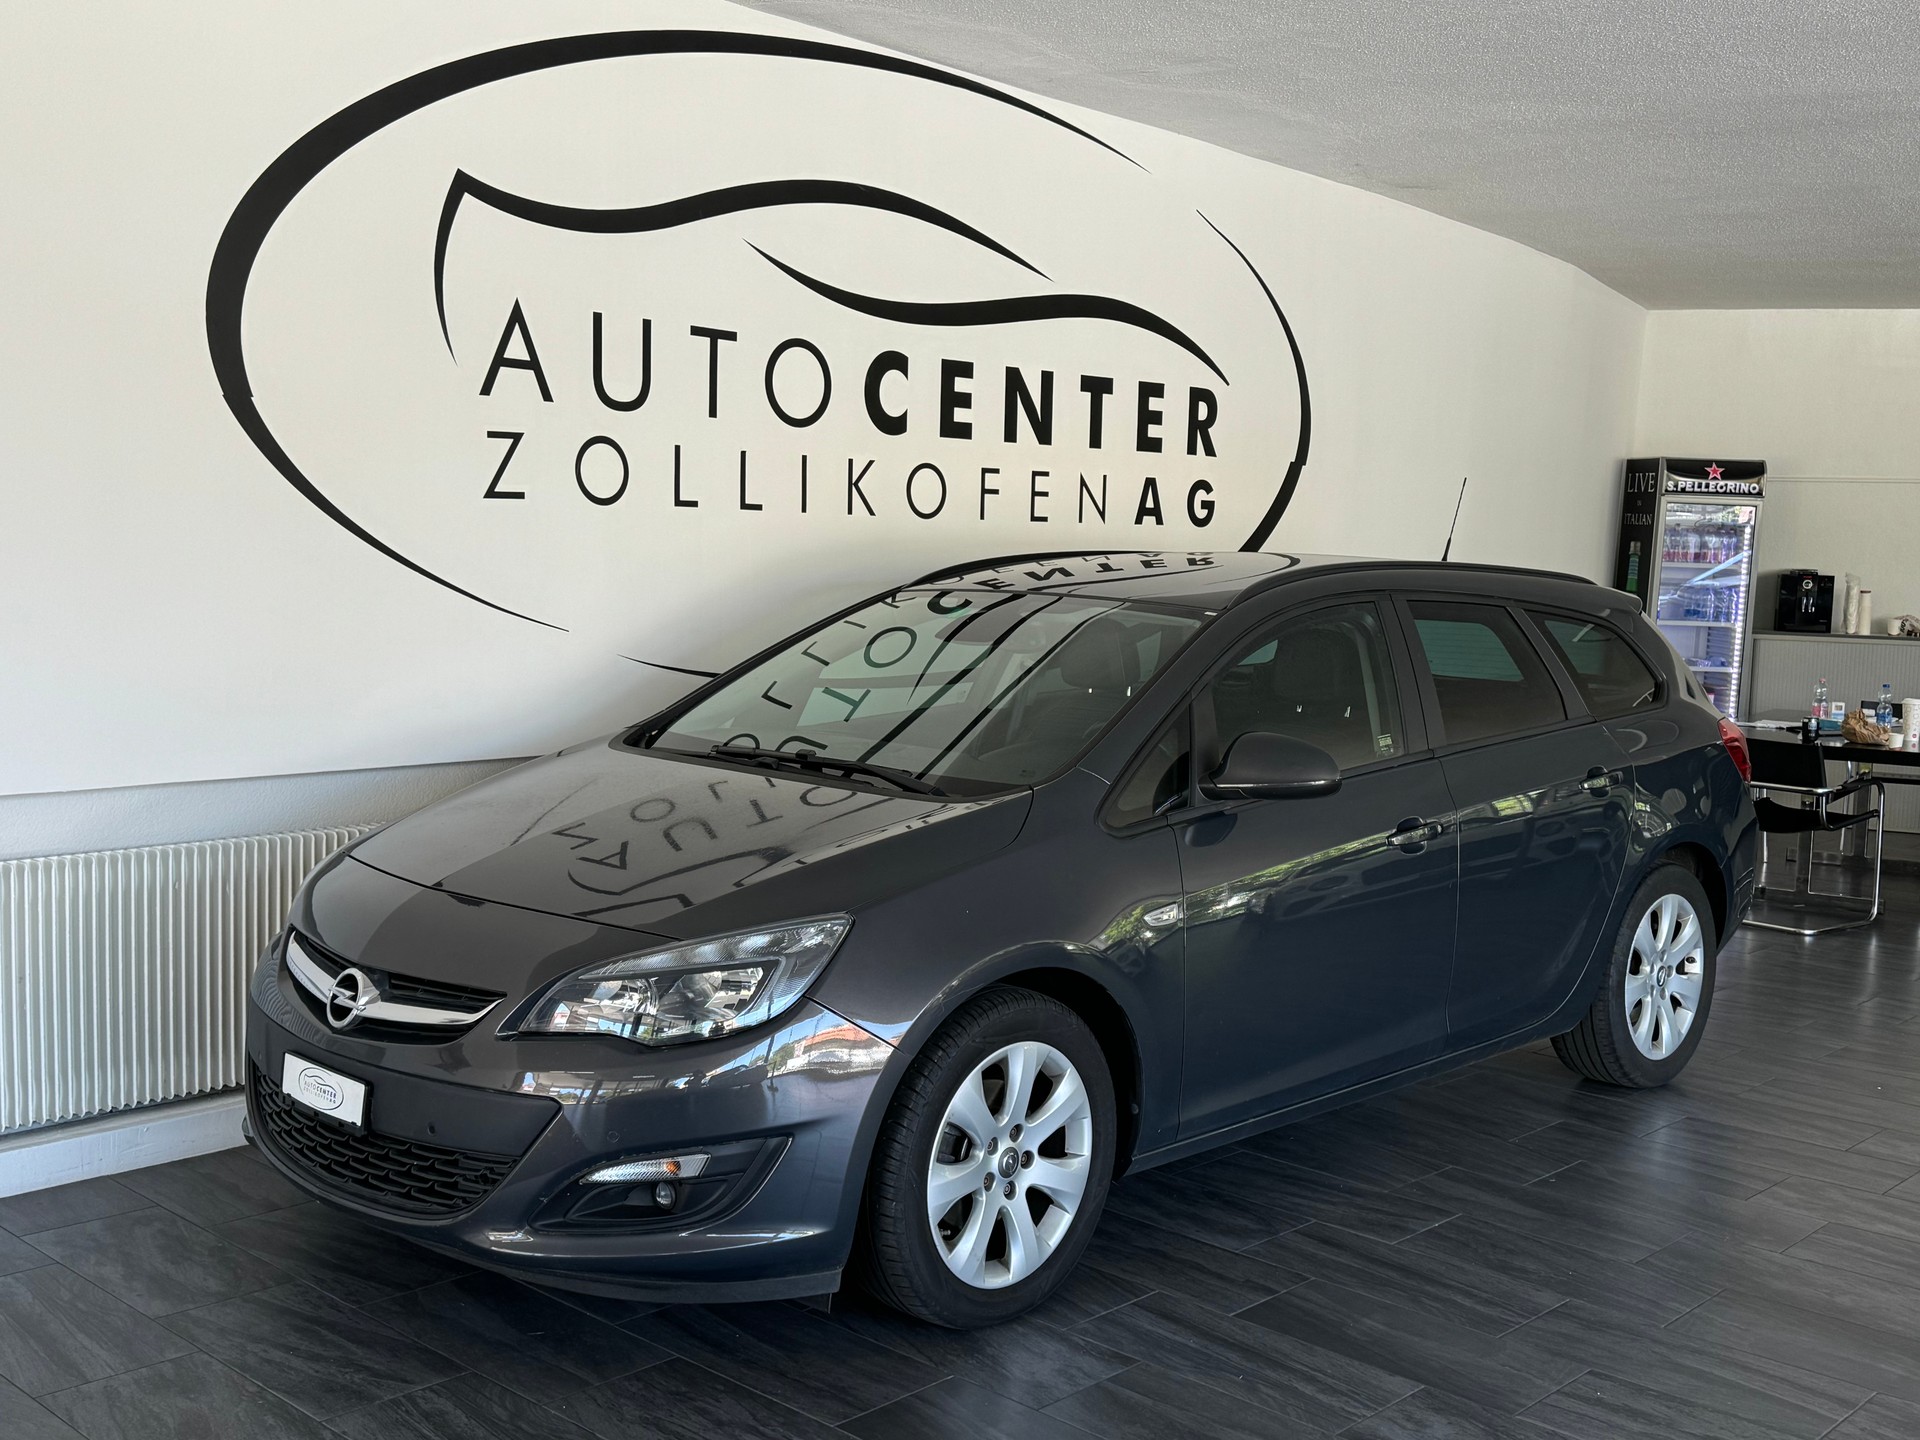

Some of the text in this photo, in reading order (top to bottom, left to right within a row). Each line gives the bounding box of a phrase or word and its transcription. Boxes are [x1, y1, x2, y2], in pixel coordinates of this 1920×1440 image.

[479, 297, 1219, 458] AUTOCENTER
[1627, 472, 1656, 493] LIVE
[1624, 513, 1653, 525] ITALIAN
